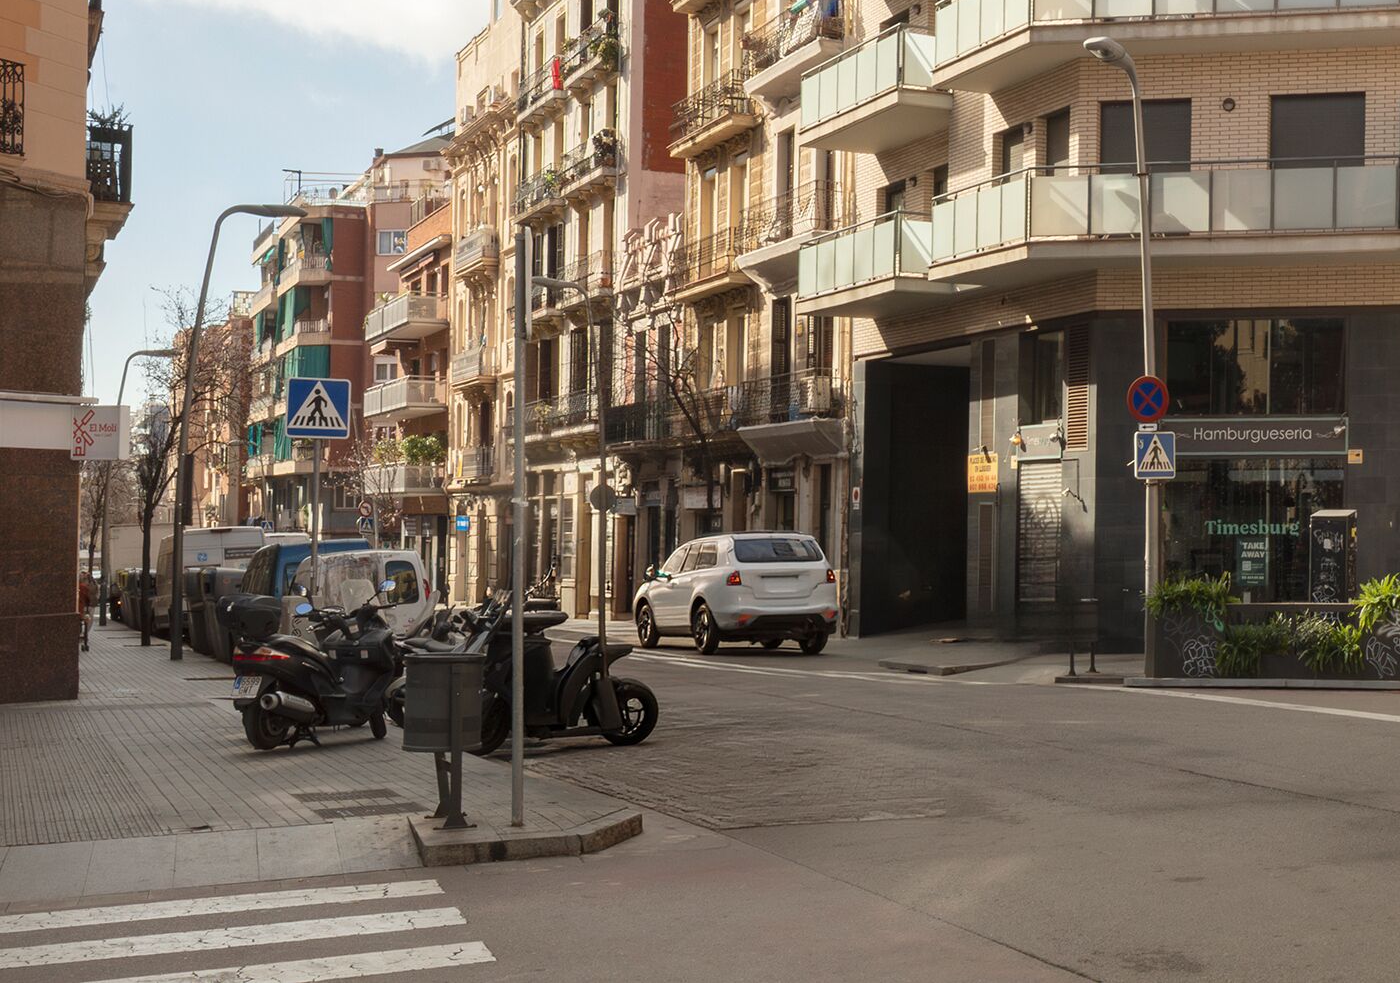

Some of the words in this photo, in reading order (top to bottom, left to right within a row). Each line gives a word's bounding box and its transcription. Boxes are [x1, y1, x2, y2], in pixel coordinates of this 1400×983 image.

[1193, 427, 1312, 443] Hamburgueseria
[1204, 519, 1300, 537] Timesburg
[1242, 542, 1265, 550] TAKE
